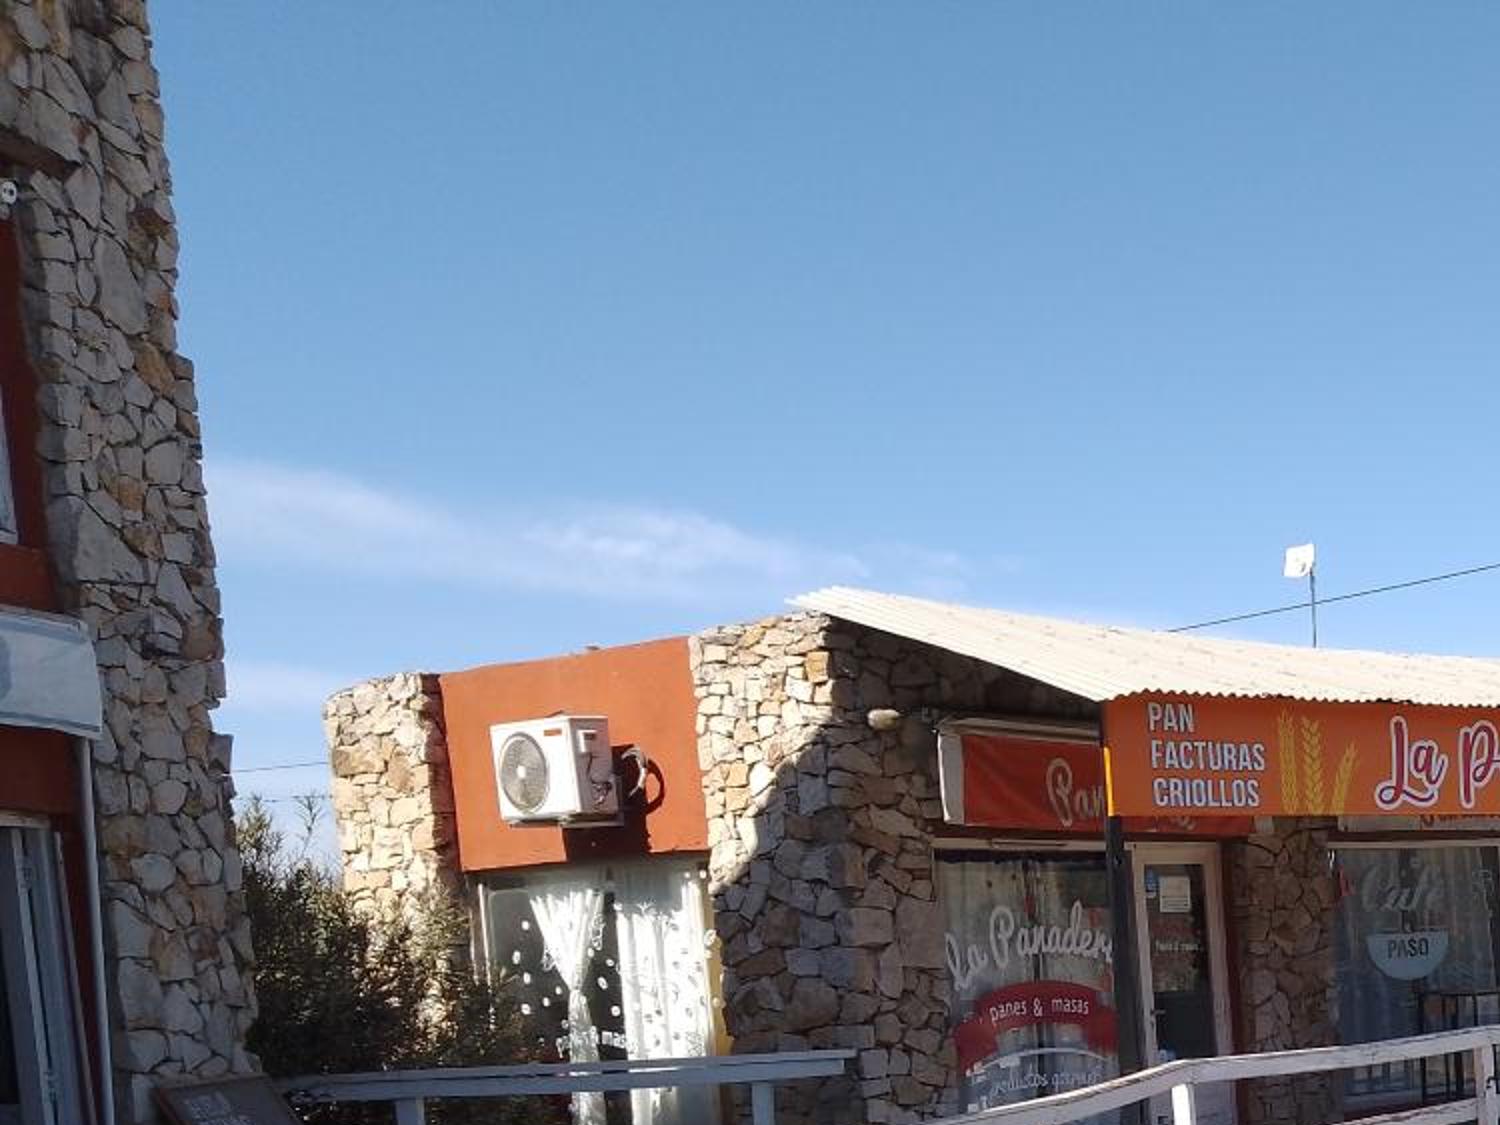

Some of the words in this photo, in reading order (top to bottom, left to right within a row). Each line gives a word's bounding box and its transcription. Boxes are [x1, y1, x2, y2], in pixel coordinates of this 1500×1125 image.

[1148, 702, 1195, 733] PAN
[1151, 740, 1266, 770] FACTURAS
[1376, 714, 1449, 811] La
[1153, 777, 1260, 807] CRIOLLOS
[1387, 929, 1429, 958] PASO
[989, 1000, 1028, 1023] panes
[1033, 997, 1044, 1017] &
[1051, 997, 1089, 1015] masas
